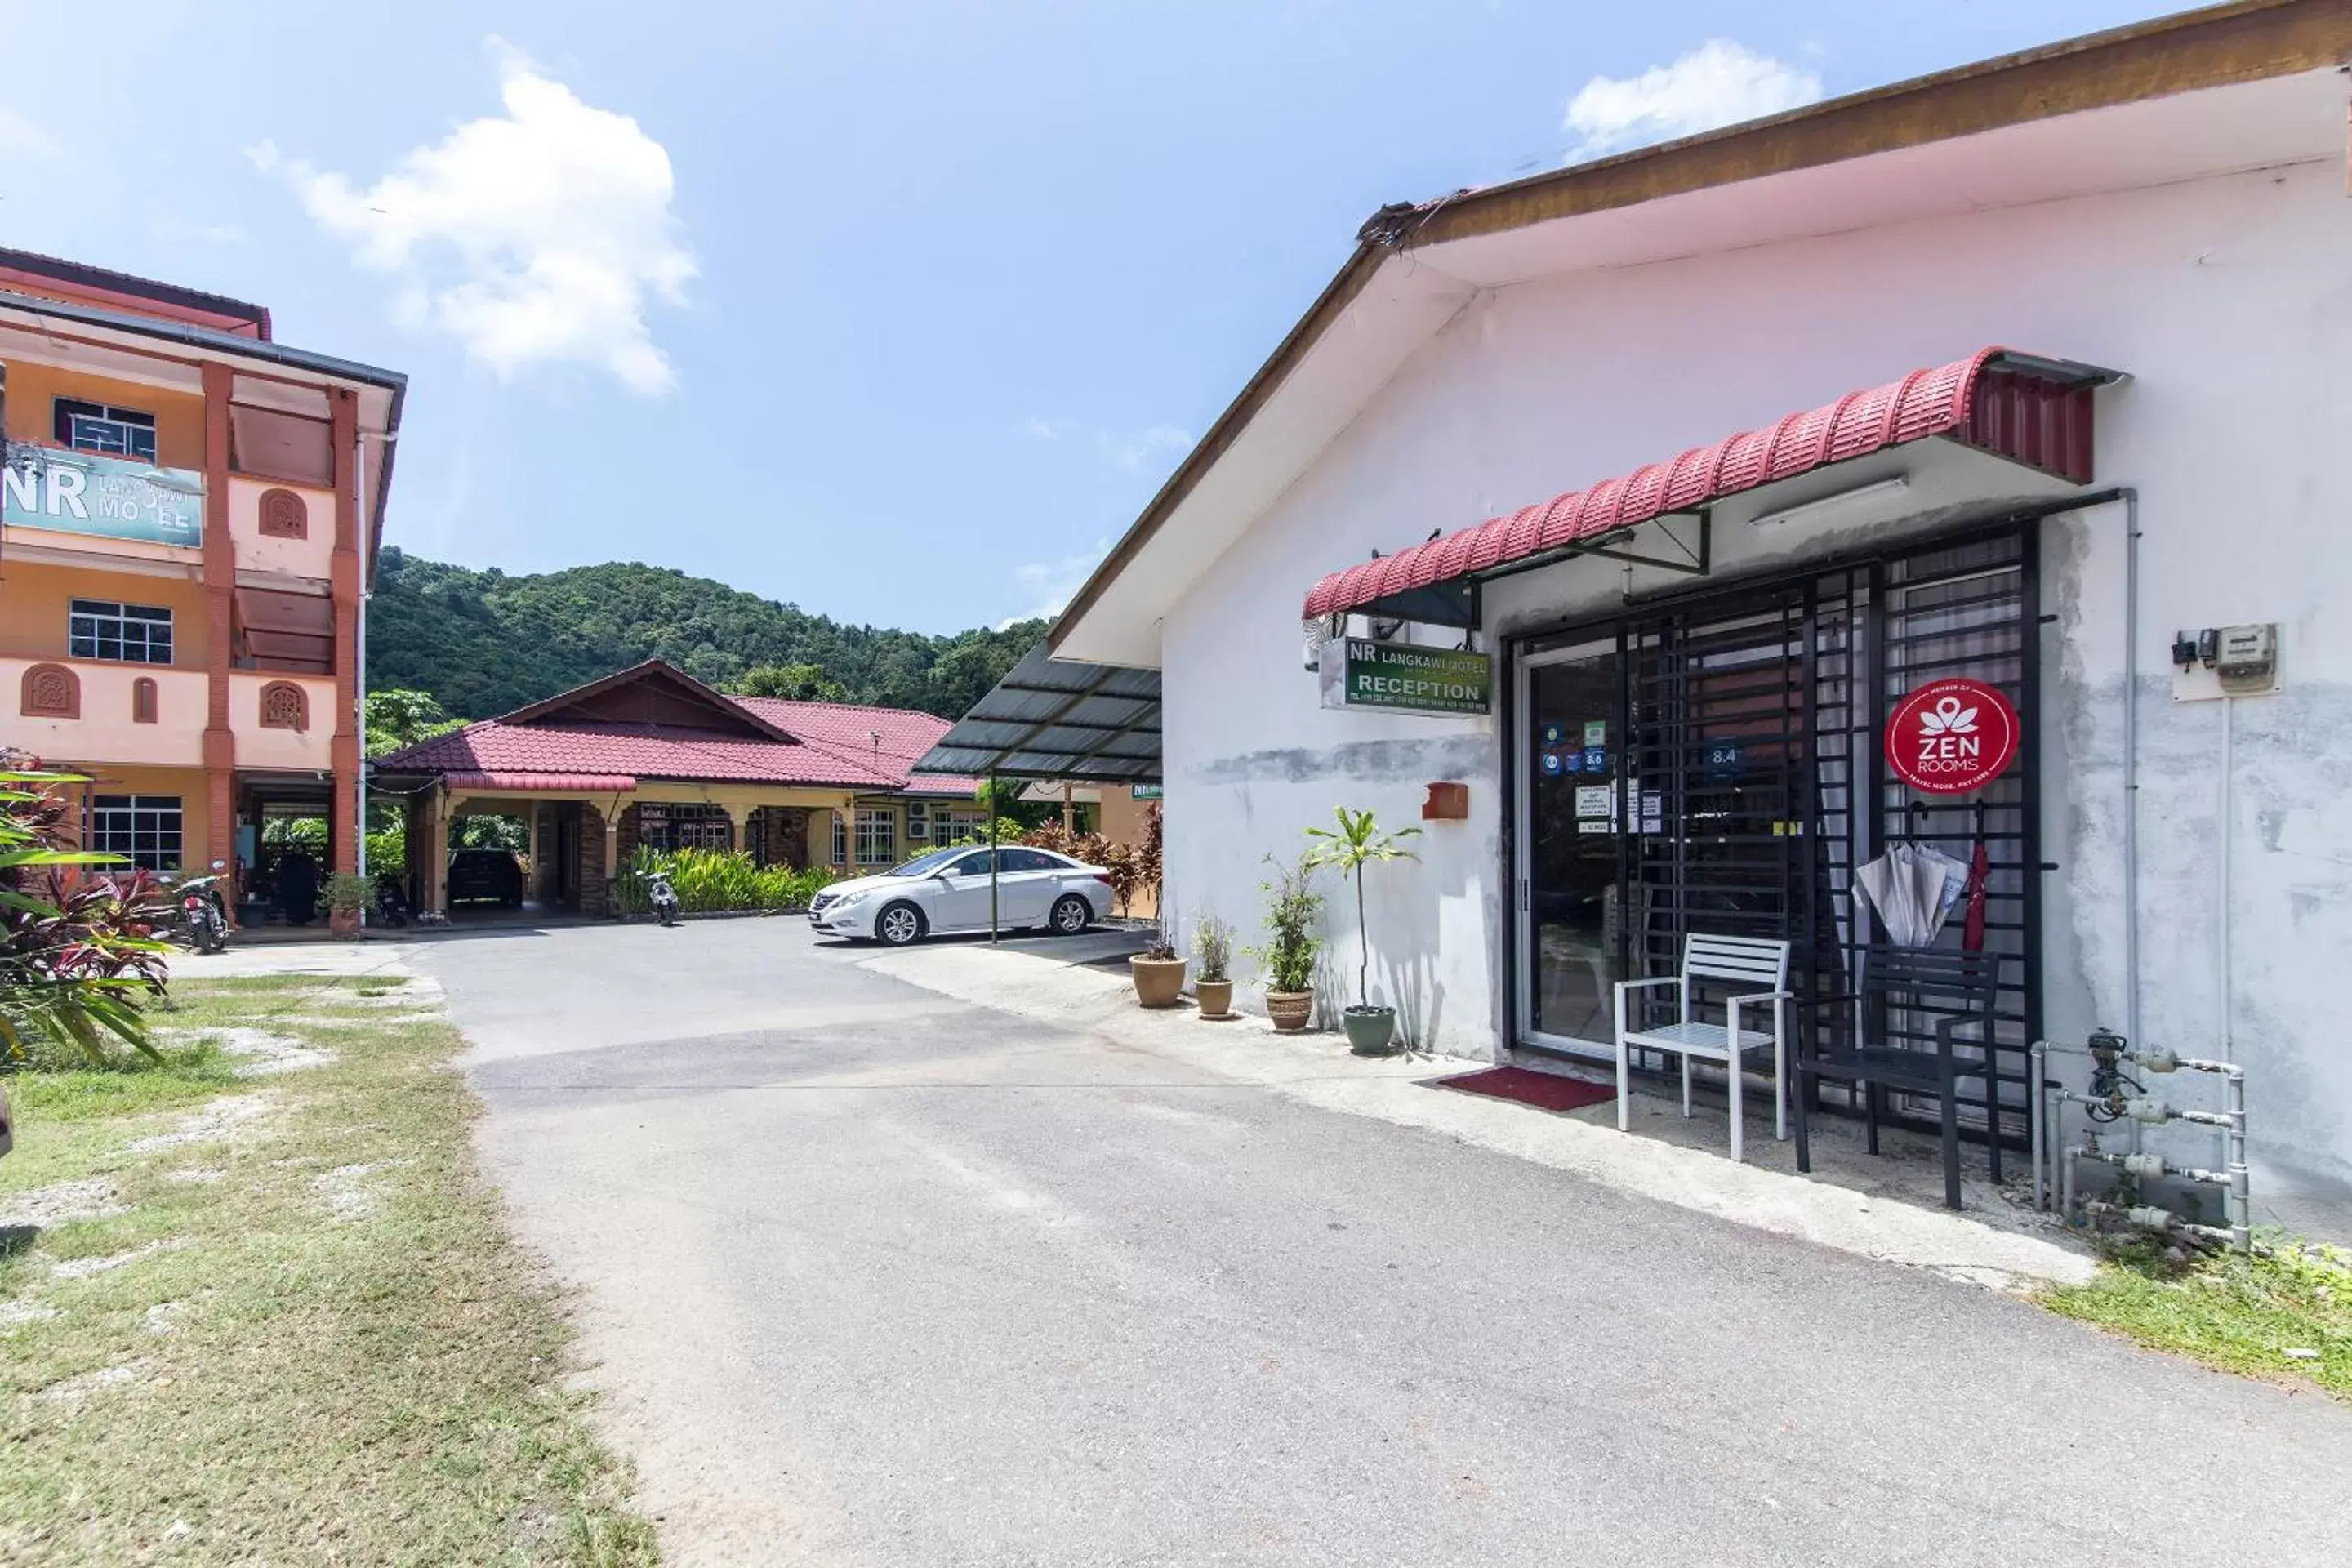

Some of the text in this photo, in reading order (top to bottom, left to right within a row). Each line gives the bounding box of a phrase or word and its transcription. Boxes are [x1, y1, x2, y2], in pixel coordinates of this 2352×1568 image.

[2, 464, 89, 519] NR
[1349, 642, 1377, 662] NR
[1382, 652, 1445, 670] LANGKAWI
[1358, 675, 1480, 701] RECEPTION
[1930, 685, 1958, 694] MEMBER
[1713, 748, 1735, 764] 8.4
[1918, 736, 1980, 760] ZEN
[1918, 758, 1980, 773] ROOMS
[1909, 773, 1931, 788] TRAVEL
[1958, 778, 1972, 788] PAY
